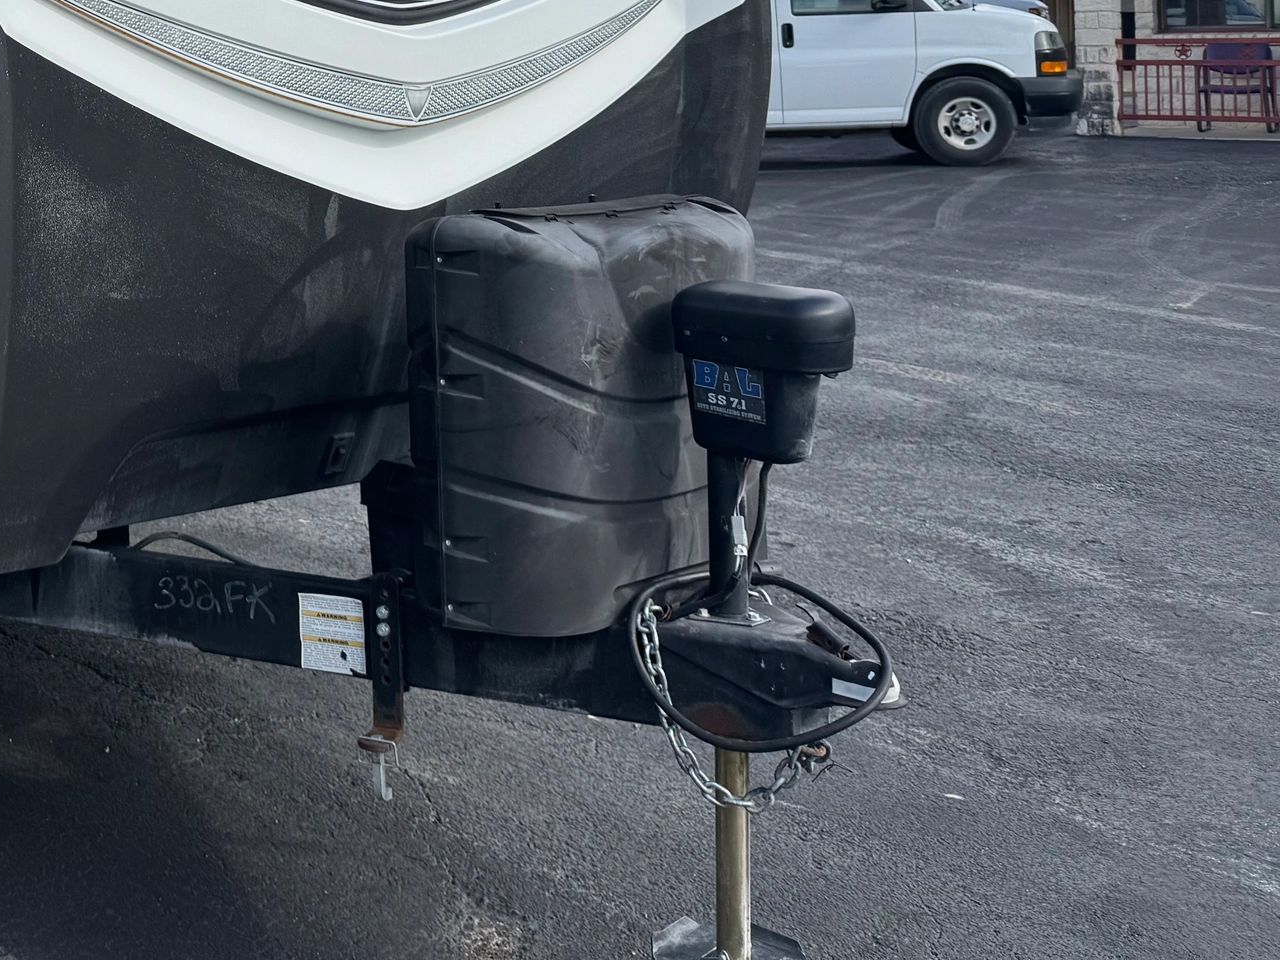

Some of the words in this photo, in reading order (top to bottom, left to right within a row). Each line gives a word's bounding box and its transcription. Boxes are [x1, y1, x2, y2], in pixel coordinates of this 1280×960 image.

[693, 359, 762, 399] BAL
[707, 392, 727, 406] SS
[729, 397, 747, 411] 7.1
[321, 612, 348, 621] WARNING
[322, 637, 349, 645] WARNING
